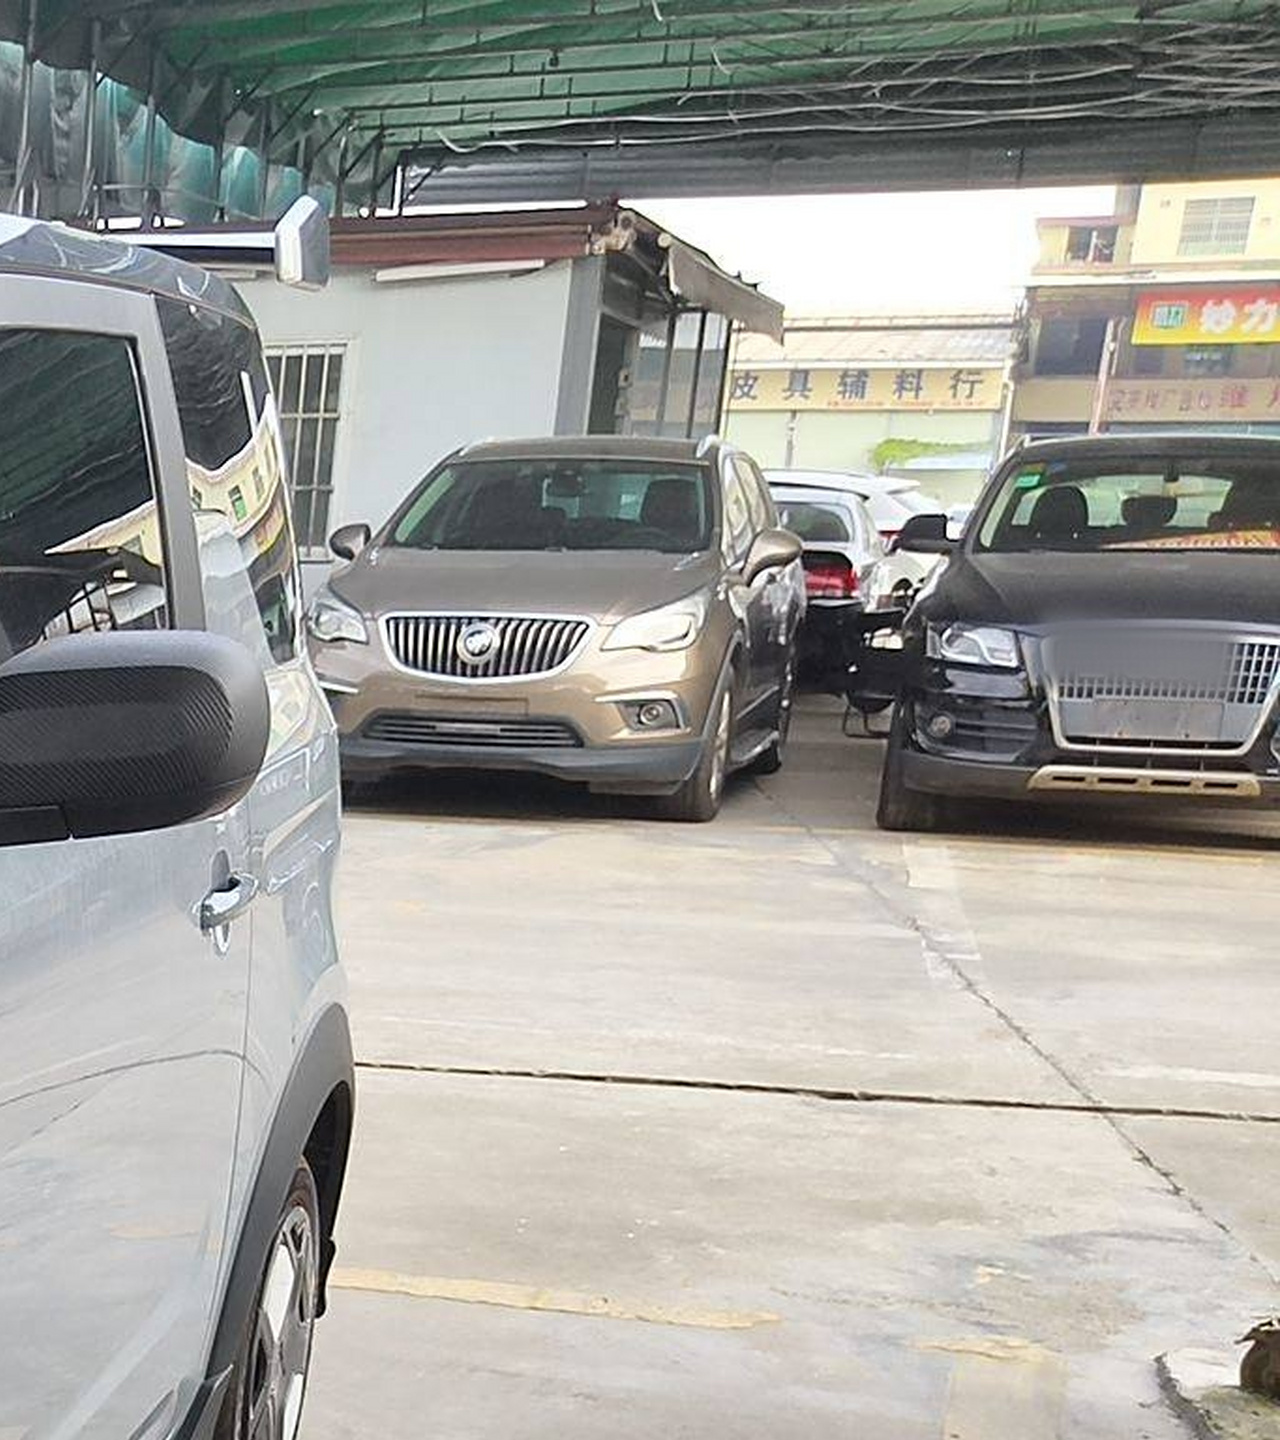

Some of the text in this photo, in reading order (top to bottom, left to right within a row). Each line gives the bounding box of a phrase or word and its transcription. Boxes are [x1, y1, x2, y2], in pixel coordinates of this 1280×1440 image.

[730, 369, 984, 401] 皮具辅料行
